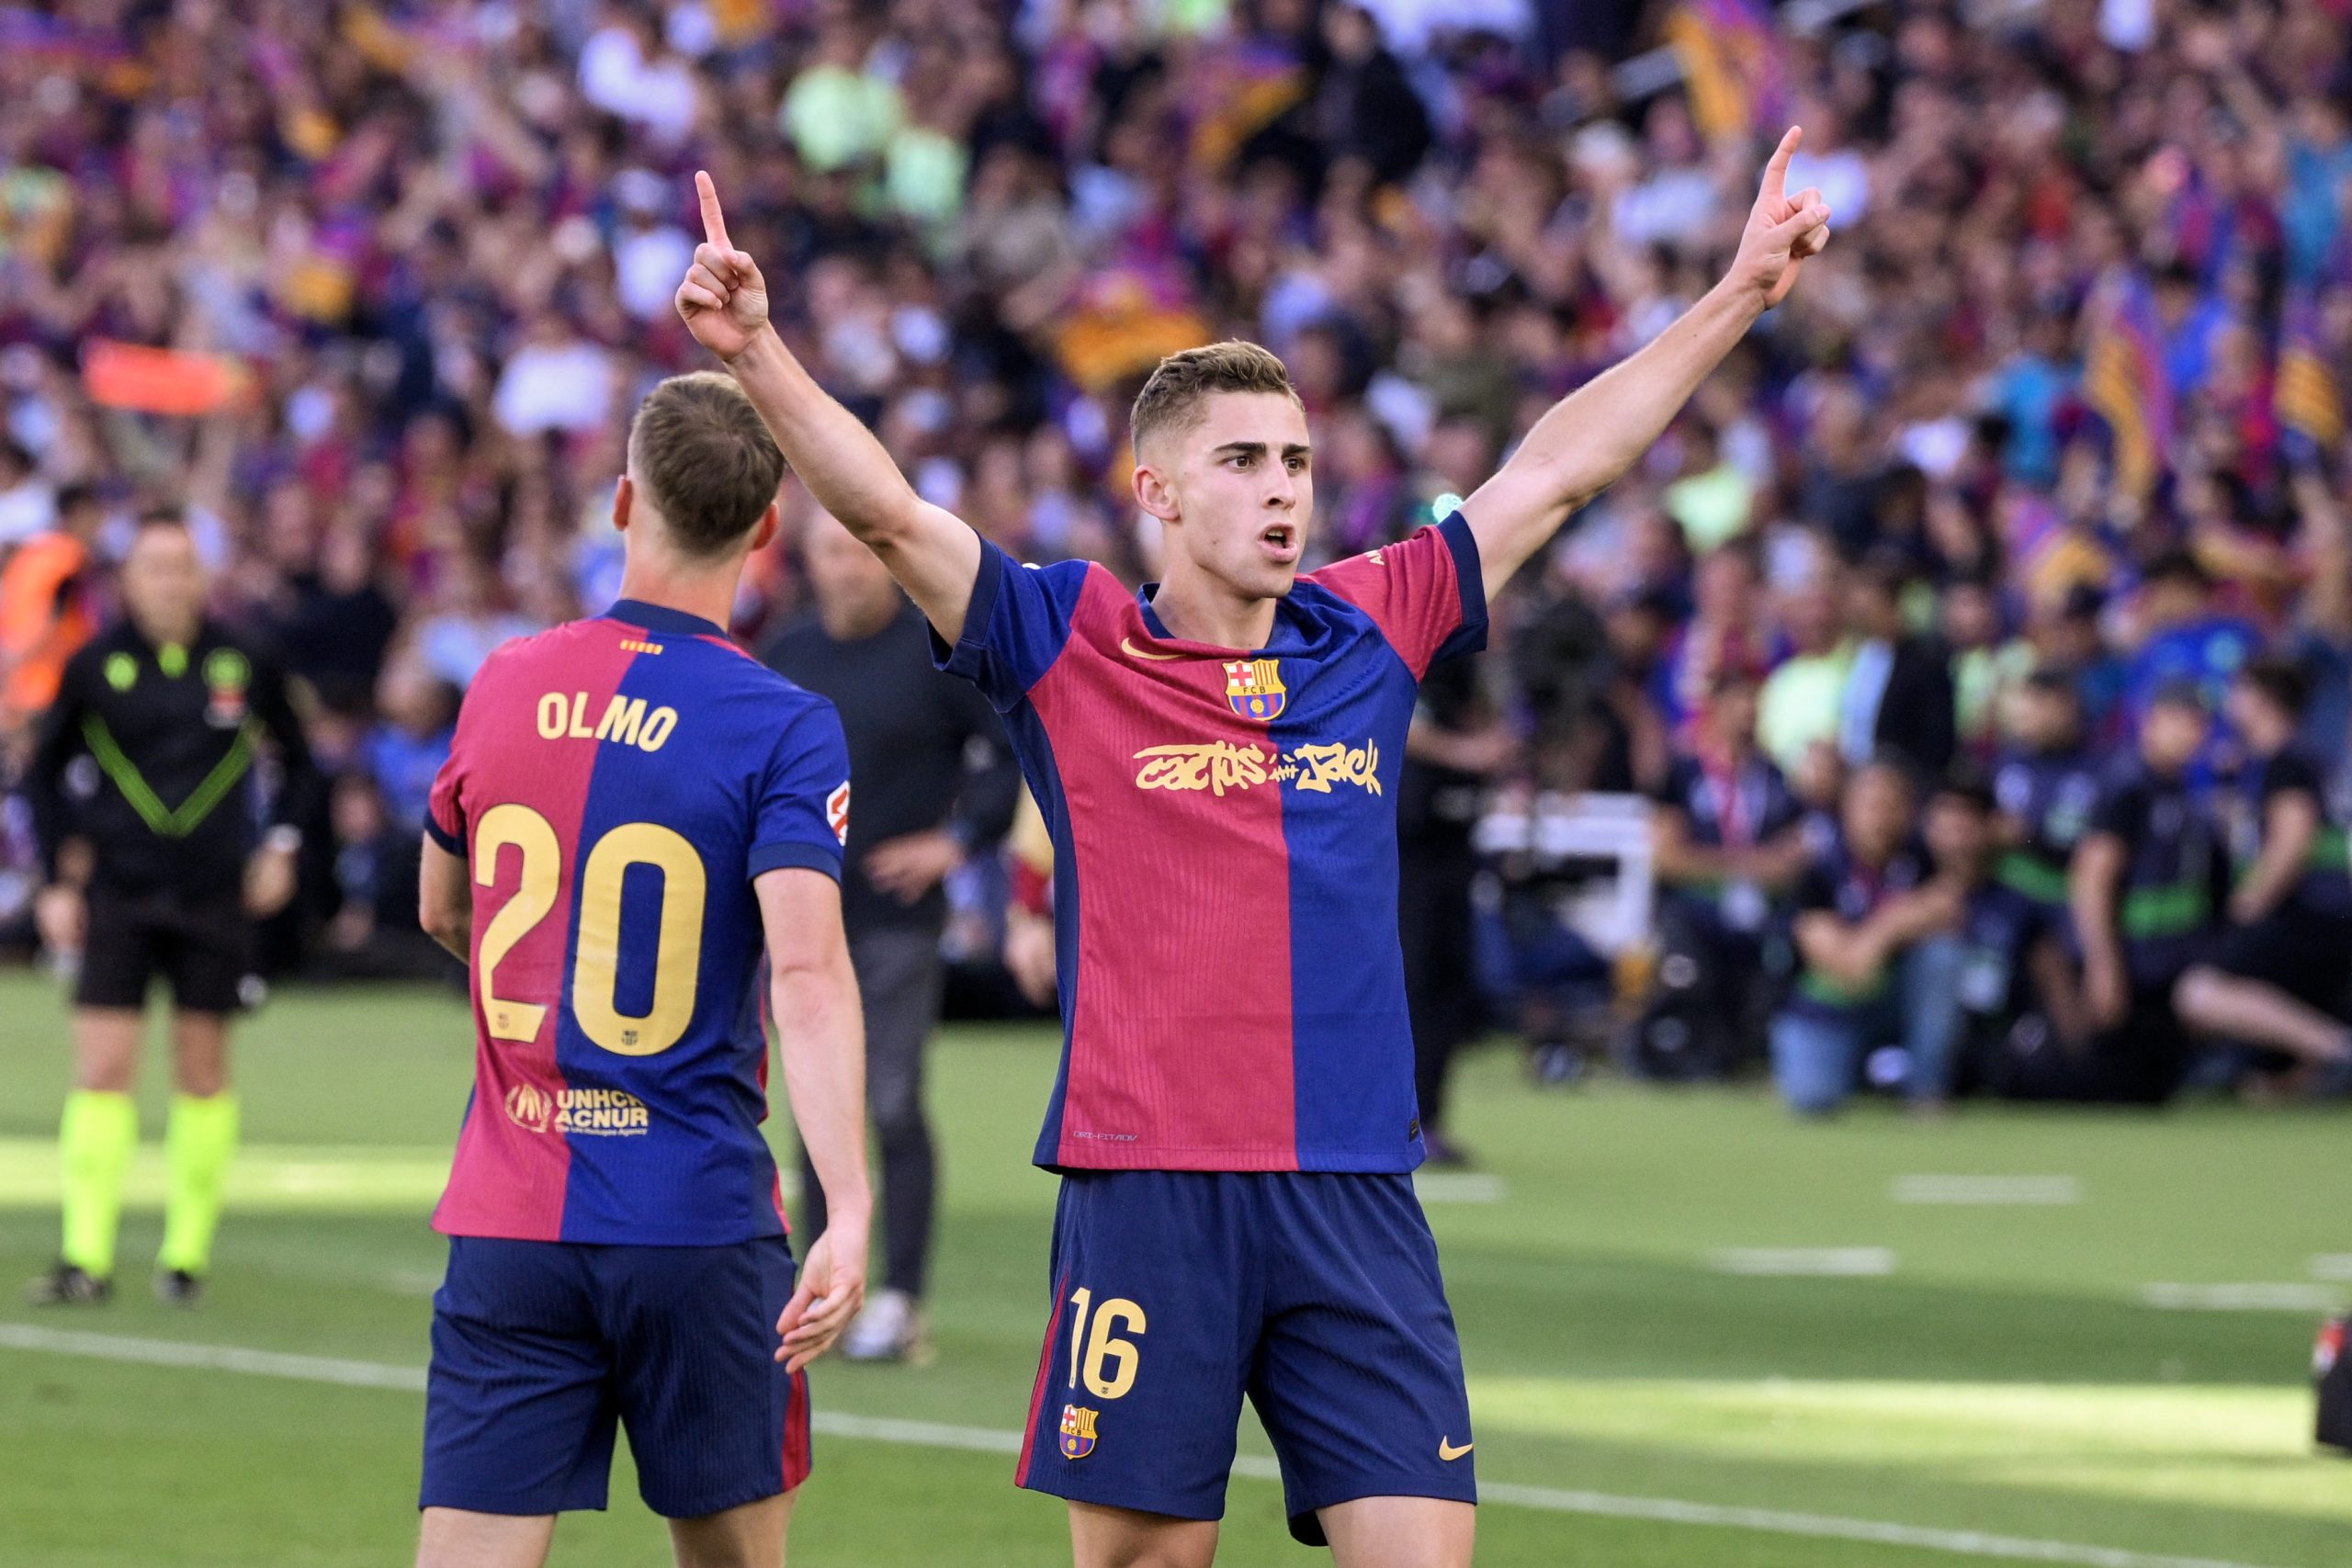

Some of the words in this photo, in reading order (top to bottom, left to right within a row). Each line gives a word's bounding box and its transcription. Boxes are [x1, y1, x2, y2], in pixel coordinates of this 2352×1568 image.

[1242, 685, 1266, 695] FCB
[537, 691, 678, 752] OLMO
[475, 803, 707, 1056] 20
[554, 1107, 648, 1128] ACNUR
[1069, 1287, 1147, 1399] 16
